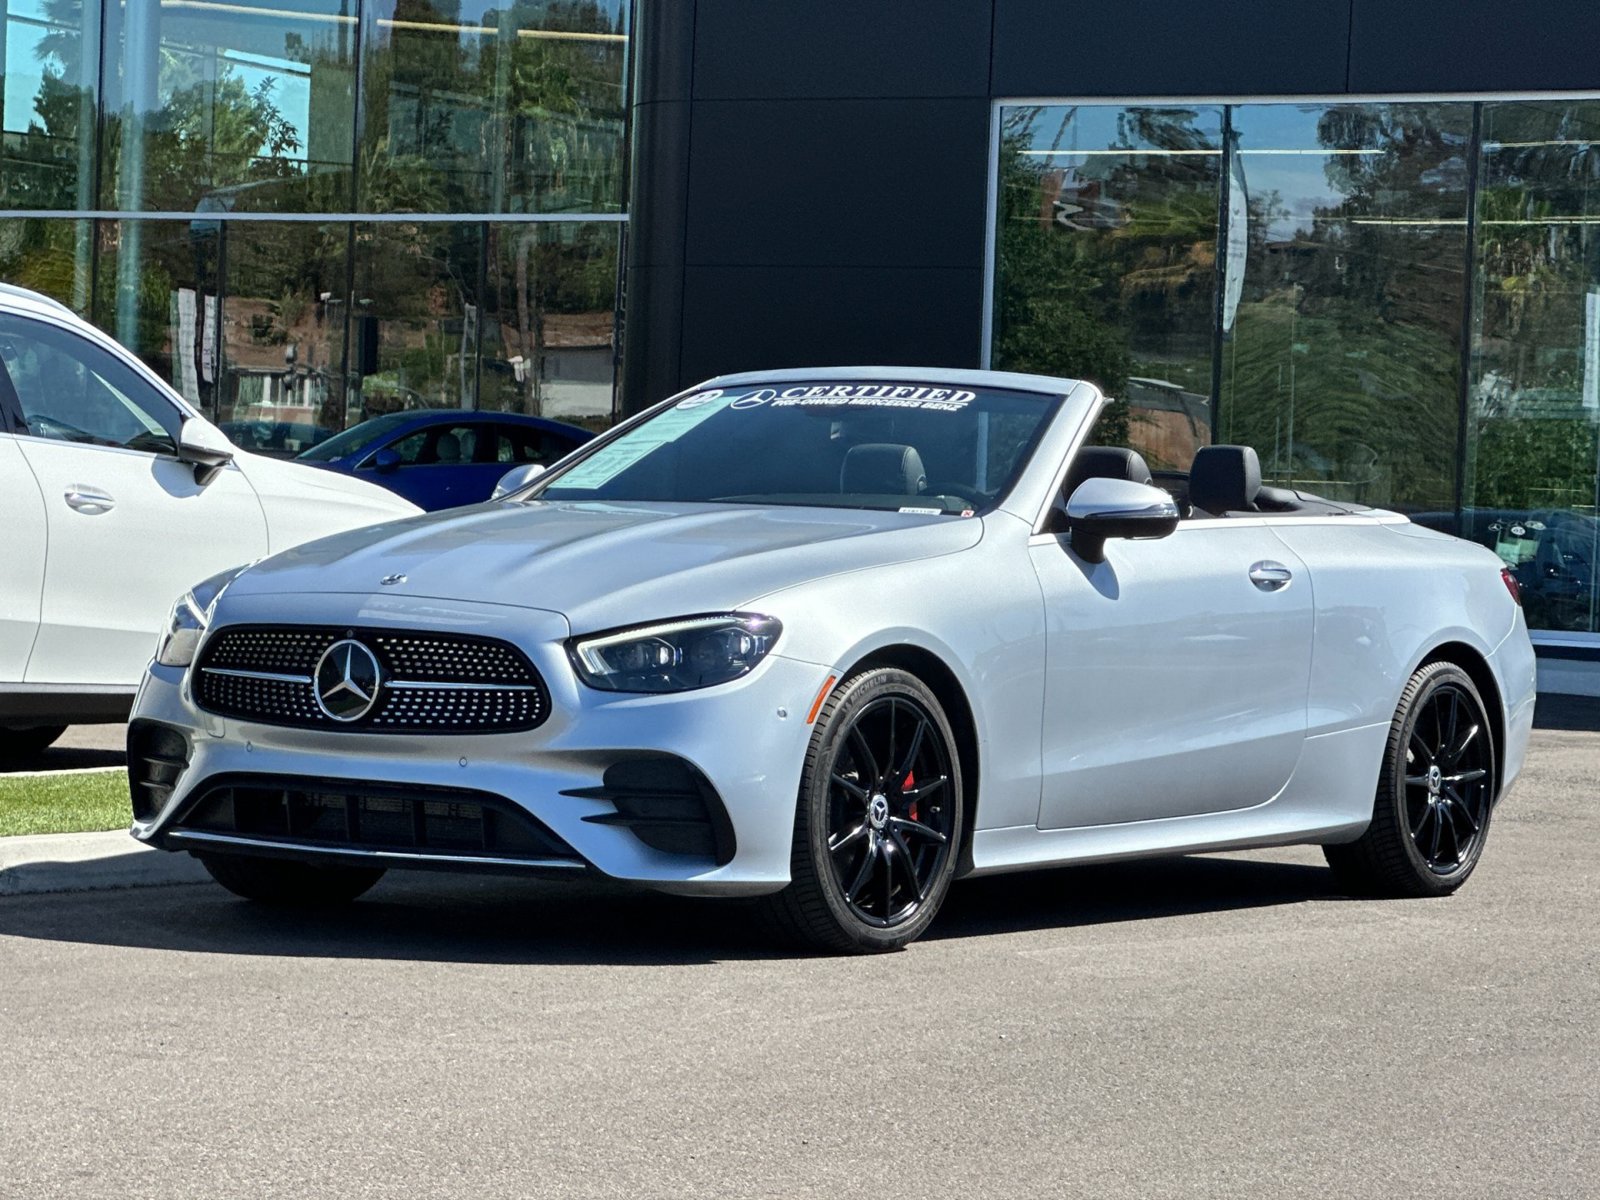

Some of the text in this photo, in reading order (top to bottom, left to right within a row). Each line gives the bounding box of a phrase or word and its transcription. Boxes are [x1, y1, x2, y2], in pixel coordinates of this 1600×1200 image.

[781, 386, 976, 403] CERTIFIED
[771, 398, 962, 411] PRE-OWNED MERCEDES BENZ
[850, 674, 887, 703] MICHELIN
